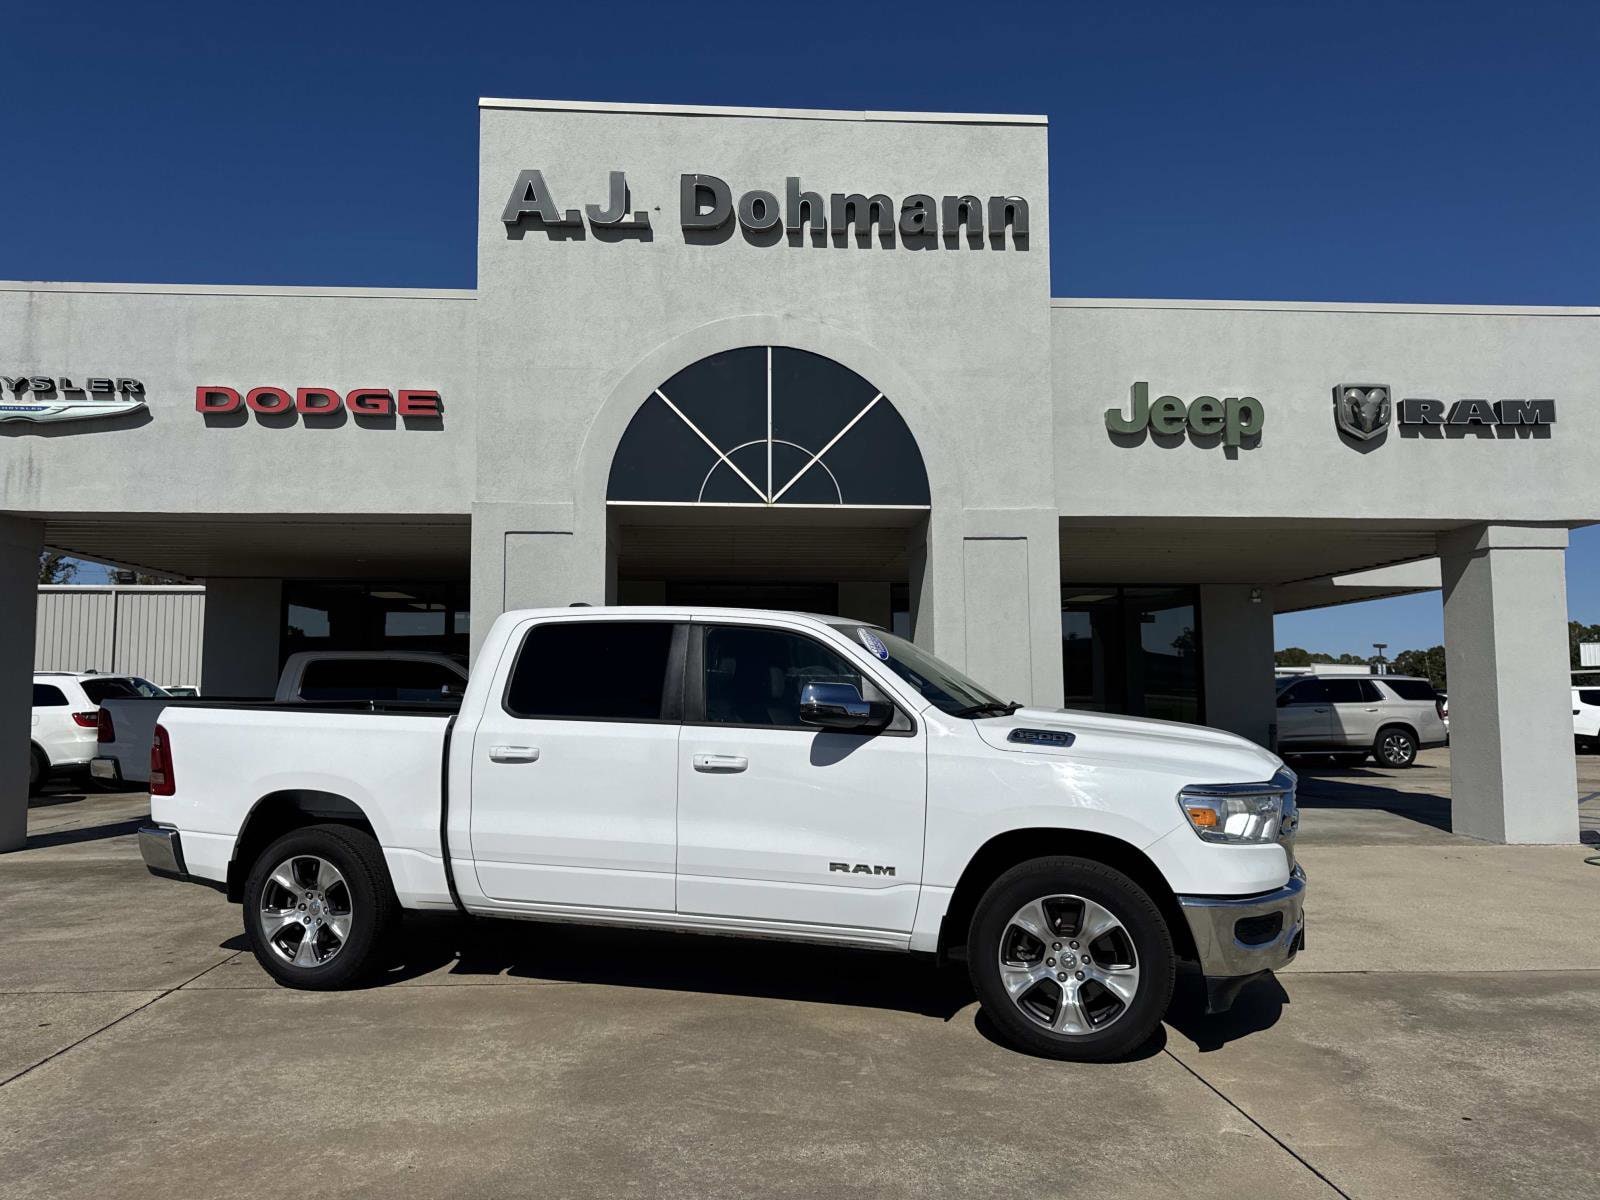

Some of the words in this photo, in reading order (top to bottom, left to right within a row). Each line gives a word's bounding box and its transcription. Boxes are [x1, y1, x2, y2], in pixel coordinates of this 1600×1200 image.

[501, 169, 649, 225] A.J.
[680, 173, 1029, 236] Dohmann
[0, 376, 142, 395] YSLER
[196, 386, 441, 417] DODGE
[1105, 381, 1265, 446] Jeep
[1400, 399, 1556, 426] RAM
[829, 862, 896, 876] RAM
